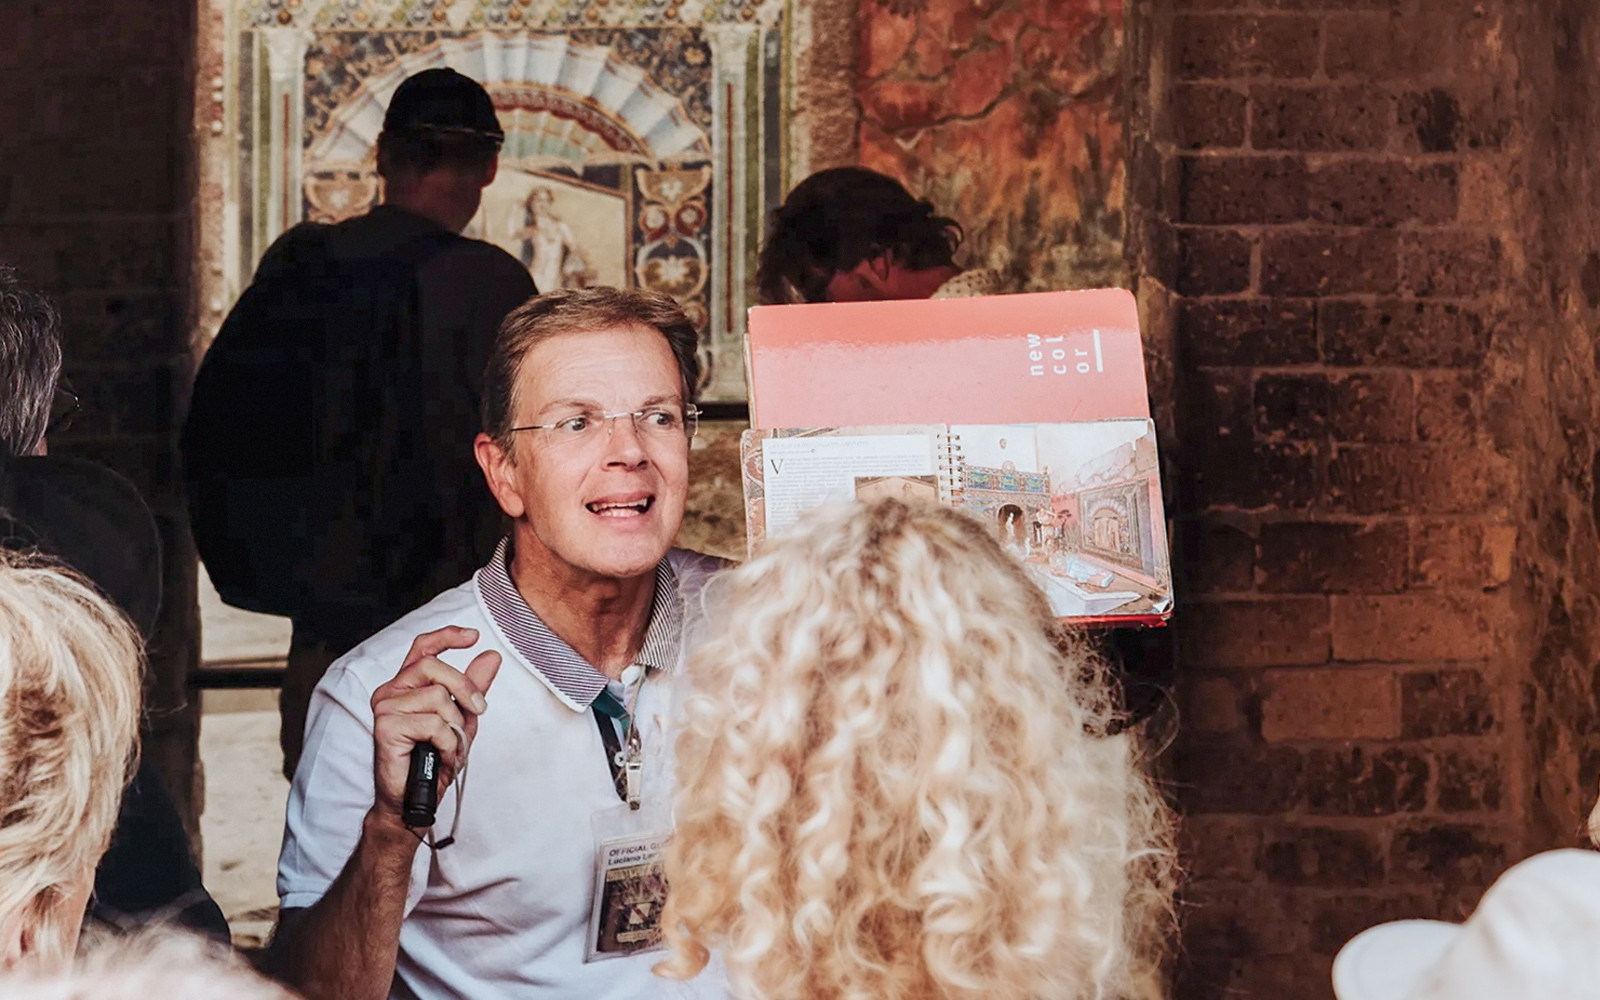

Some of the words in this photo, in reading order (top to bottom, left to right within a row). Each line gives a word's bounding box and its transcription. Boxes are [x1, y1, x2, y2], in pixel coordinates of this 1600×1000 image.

[1026, 333, 1044, 376] new
[1045, 335, 1067, 375] col
[1074, 348, 1090, 373] or
[608, 855, 641, 866] Luciano
[609, 845, 646, 857] OFFICIAL
